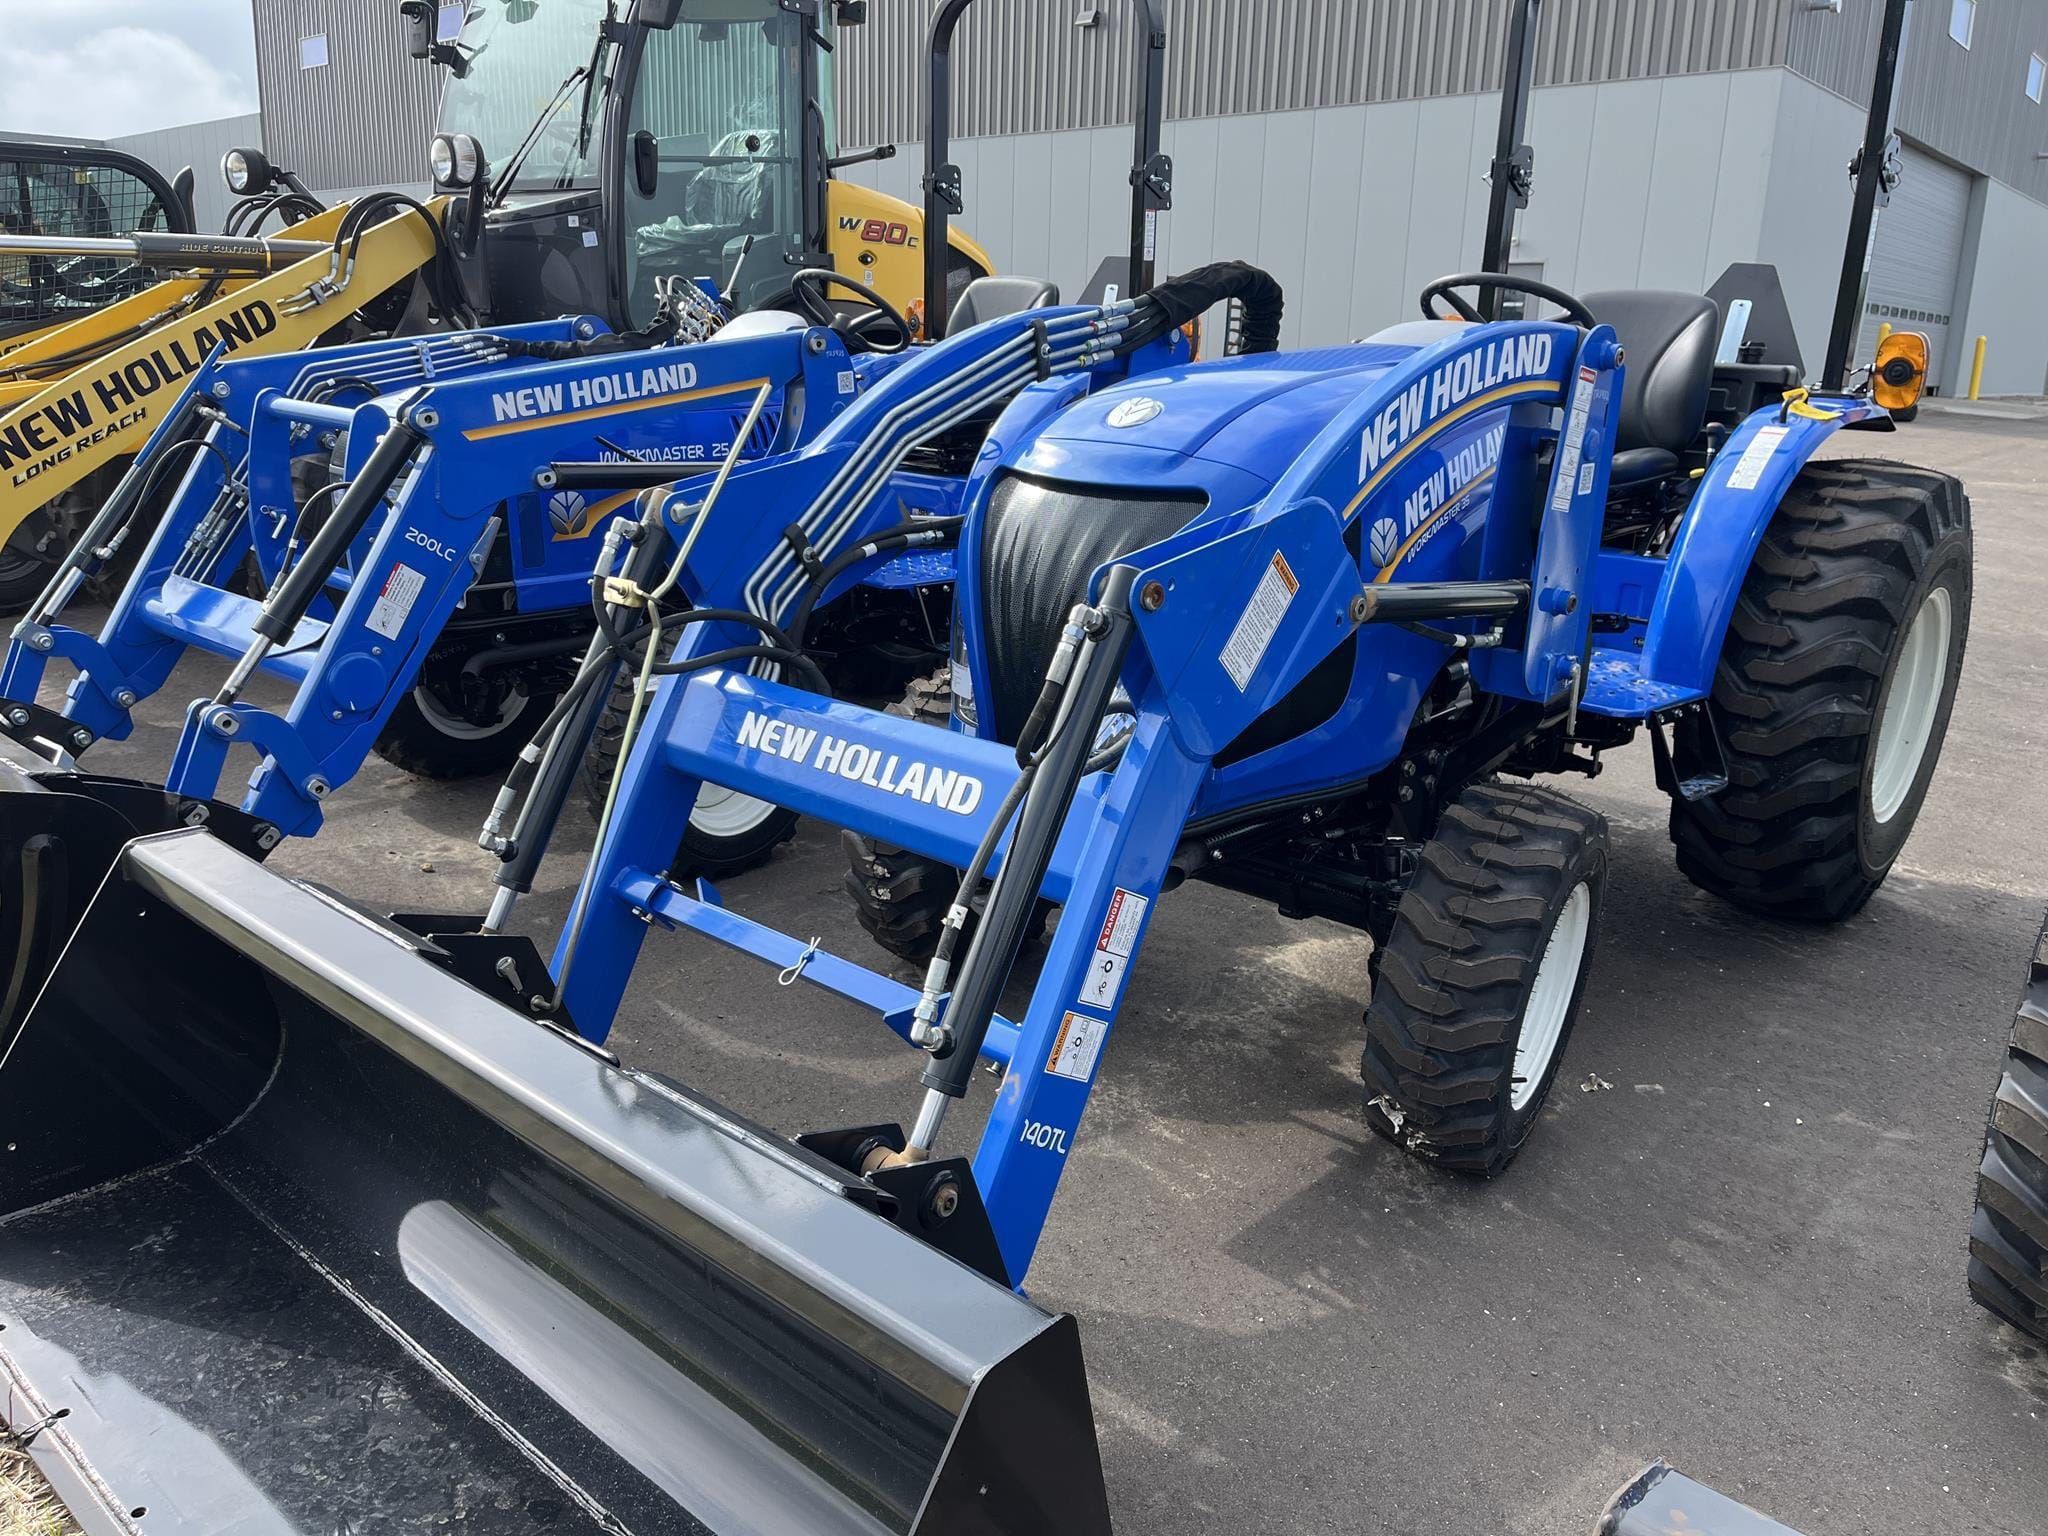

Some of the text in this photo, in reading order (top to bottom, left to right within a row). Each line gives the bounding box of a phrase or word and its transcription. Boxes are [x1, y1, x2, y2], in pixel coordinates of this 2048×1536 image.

[0, 300, 278, 471] NEW HOLLAND
[492, 361, 698, 422] NEW HOLLAND
[1358, 333, 1552, 485] NEW HOLLAND
[12, 406, 148, 488] LONG REACH
[1404, 467, 1445, 538] NEW
[1447, 423, 1505, 496] HOLLAN
[404, 526, 457, 562] 200LC
[1407, 494, 1471, 563] WORKMASTER 35
[736, 710, 983, 816] NEW HOLLAND
[1104, 894, 1123, 935] DANGER
[1052, 1018, 1071, 1058] WARNING
[1020, 1118, 1066, 1154] 140TL
